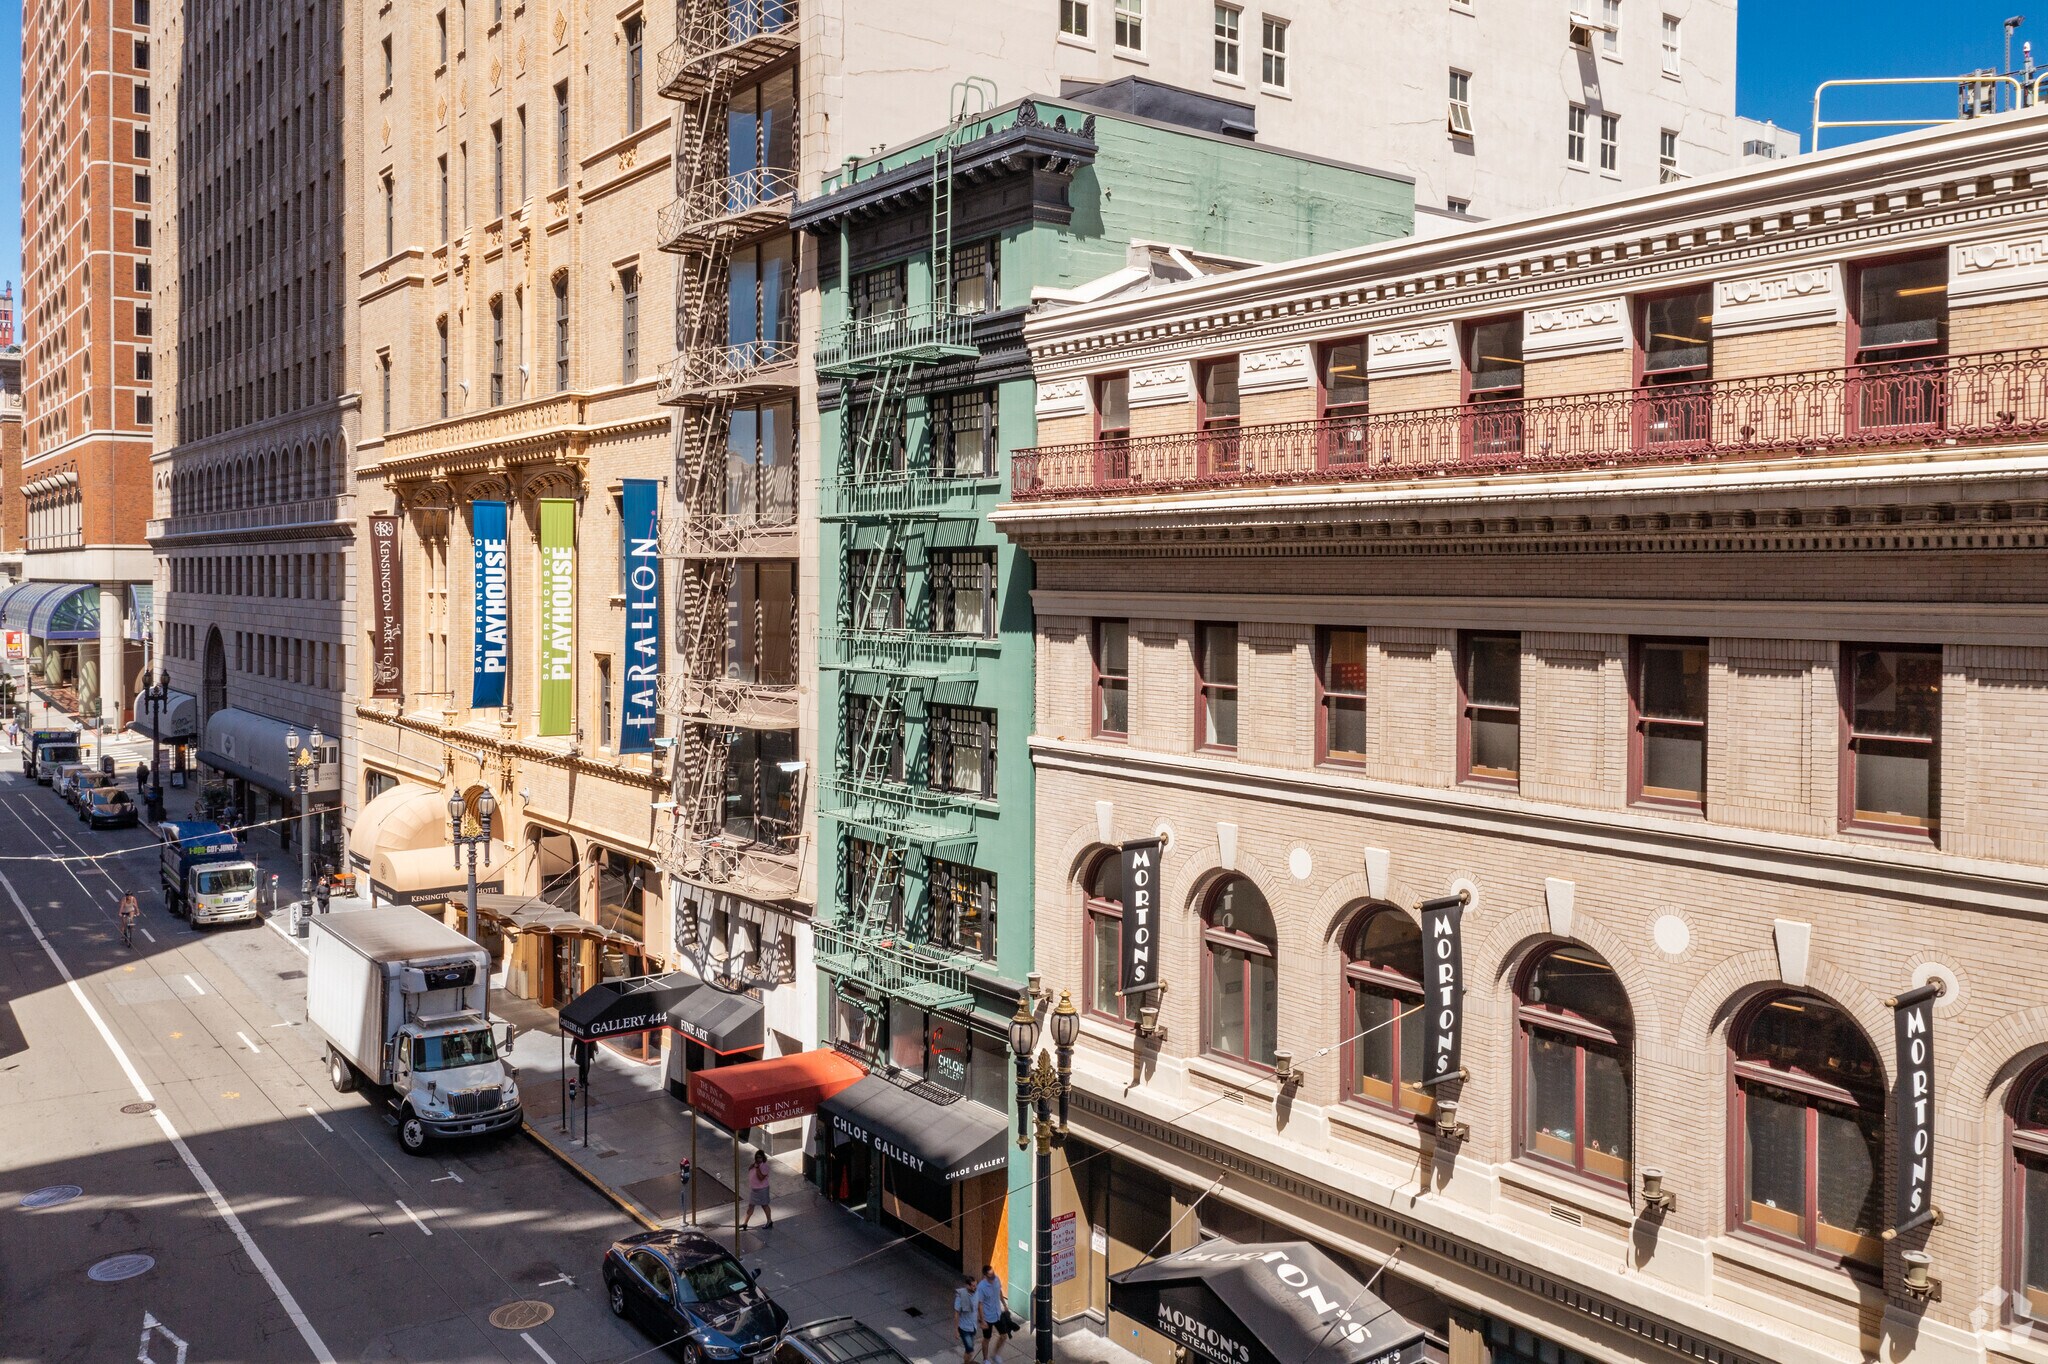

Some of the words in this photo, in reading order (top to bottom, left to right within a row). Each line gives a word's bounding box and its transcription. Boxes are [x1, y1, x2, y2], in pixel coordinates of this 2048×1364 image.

[379, 540, 392, 611] KENSINGTON
[484, 538, 507, 673] PLAYHOUSE
[551, 546, 572, 680] PLAYHOUSE
[384, 616, 394, 643] PARK
[626, 538, 657, 729] FARALLON
[383, 646, 394, 683] HOTEL
[474, 644, 483, 673] SAN
[542, 651, 550, 680] SAN
[411, 890, 449, 903] KENSINGTO
[477, 886, 498, 894] HOTEL
[1132, 850, 1151, 982] MORTONS
[1434, 914, 1454, 1074] MORTONS
[559, 1017, 578, 1034] GALLERY
[590, 1014, 646, 1034] GALLERY
[648, 1011, 668, 1025] 444
[680, 1019, 695, 1036] FINE
[693, 1027, 709, 1042] ART
[938, 1054, 964, 1074] CHLOE
[938, 1065, 964, 1081] GALLERY
[750, 1112, 776, 1125] UNION
[776, 1106, 804, 1119] SQUARE
[755, 1105, 771, 1115] THE
[775, 1100, 790, 1111] INN
[1907, 1007, 1928, 1213] MORTONS
[833, 1115, 868, 1143] CHLOE
[874, 1136, 924, 1173] GALLERY
[945, 1167, 970, 1180] CHLOE
[974, 1156, 1006, 1171] GALLERY
[1177, 1251, 1372, 1344] MORTON'S
[1157, 1318, 1177, 1336] THE
[1157, 1302, 1250, 1363] MORTON'S
